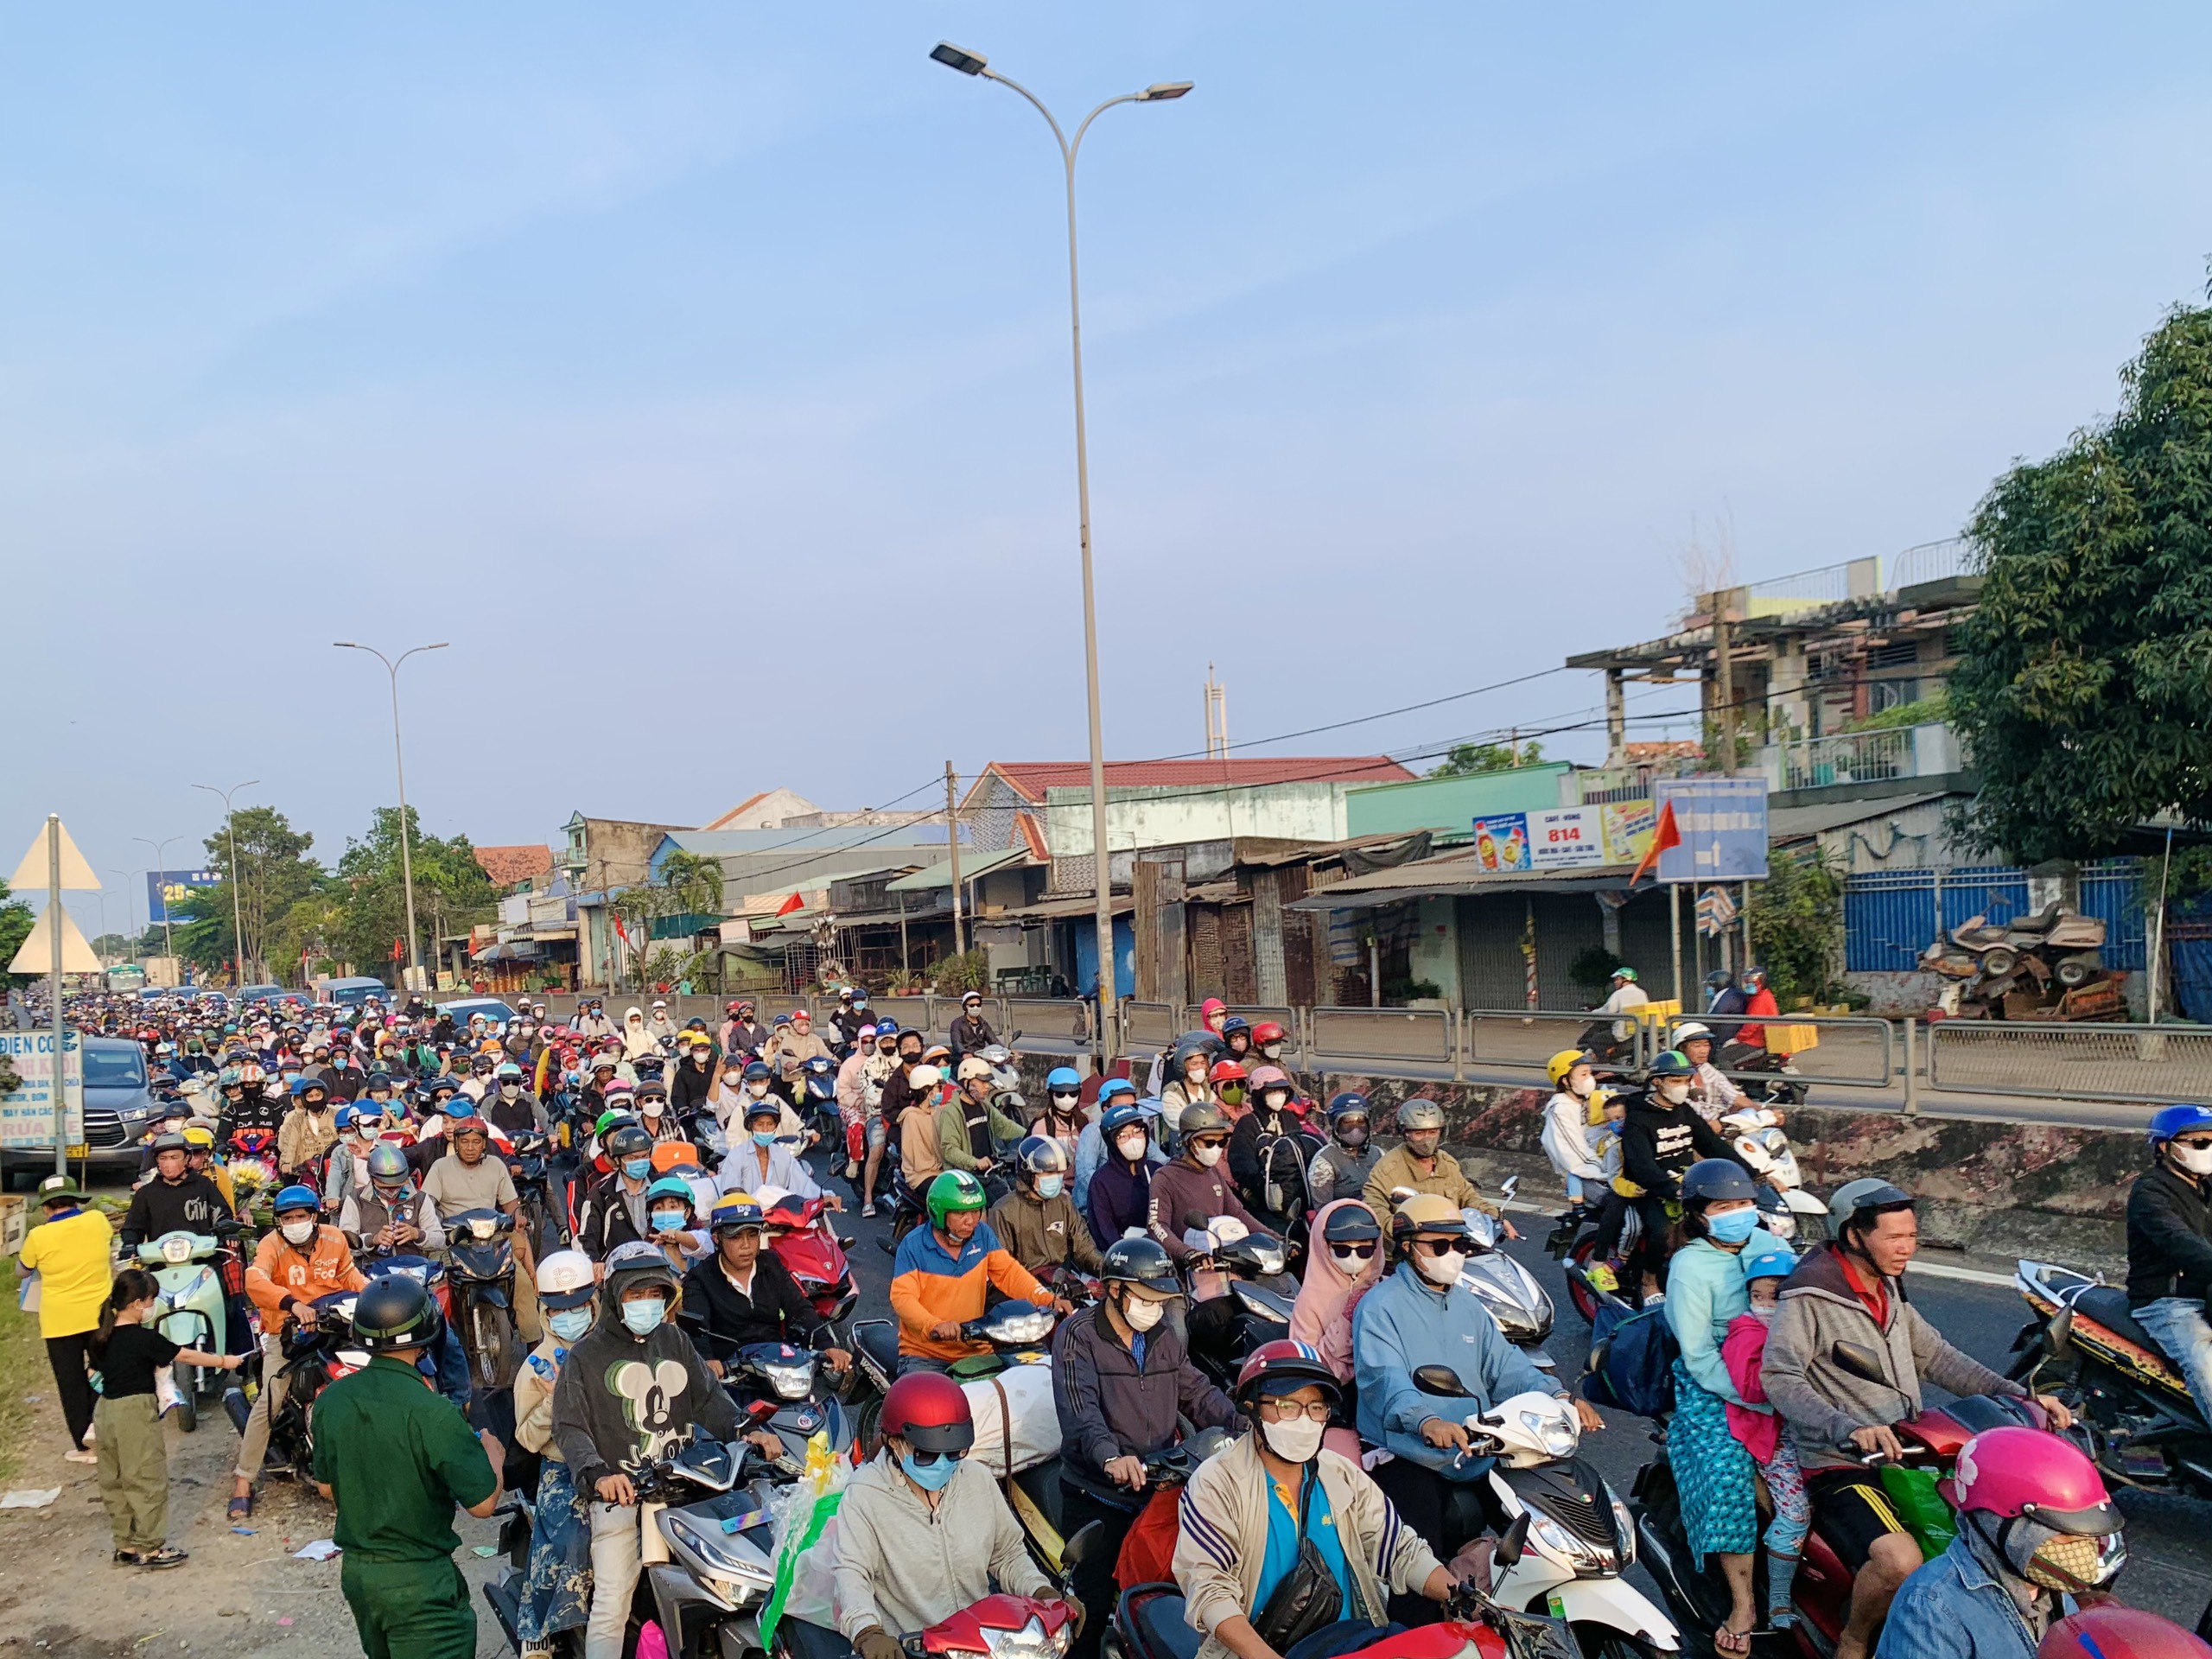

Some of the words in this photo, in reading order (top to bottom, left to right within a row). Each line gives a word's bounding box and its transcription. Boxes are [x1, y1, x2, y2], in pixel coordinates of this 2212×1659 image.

[1548, 827, 1581, 842] 814
[964, 1193, 983, 1205] Grab
[736, 1205, 752, 1214] be
[314, 1267, 336, 1280] Foo
[702, 1457, 722, 1466] HONDA
